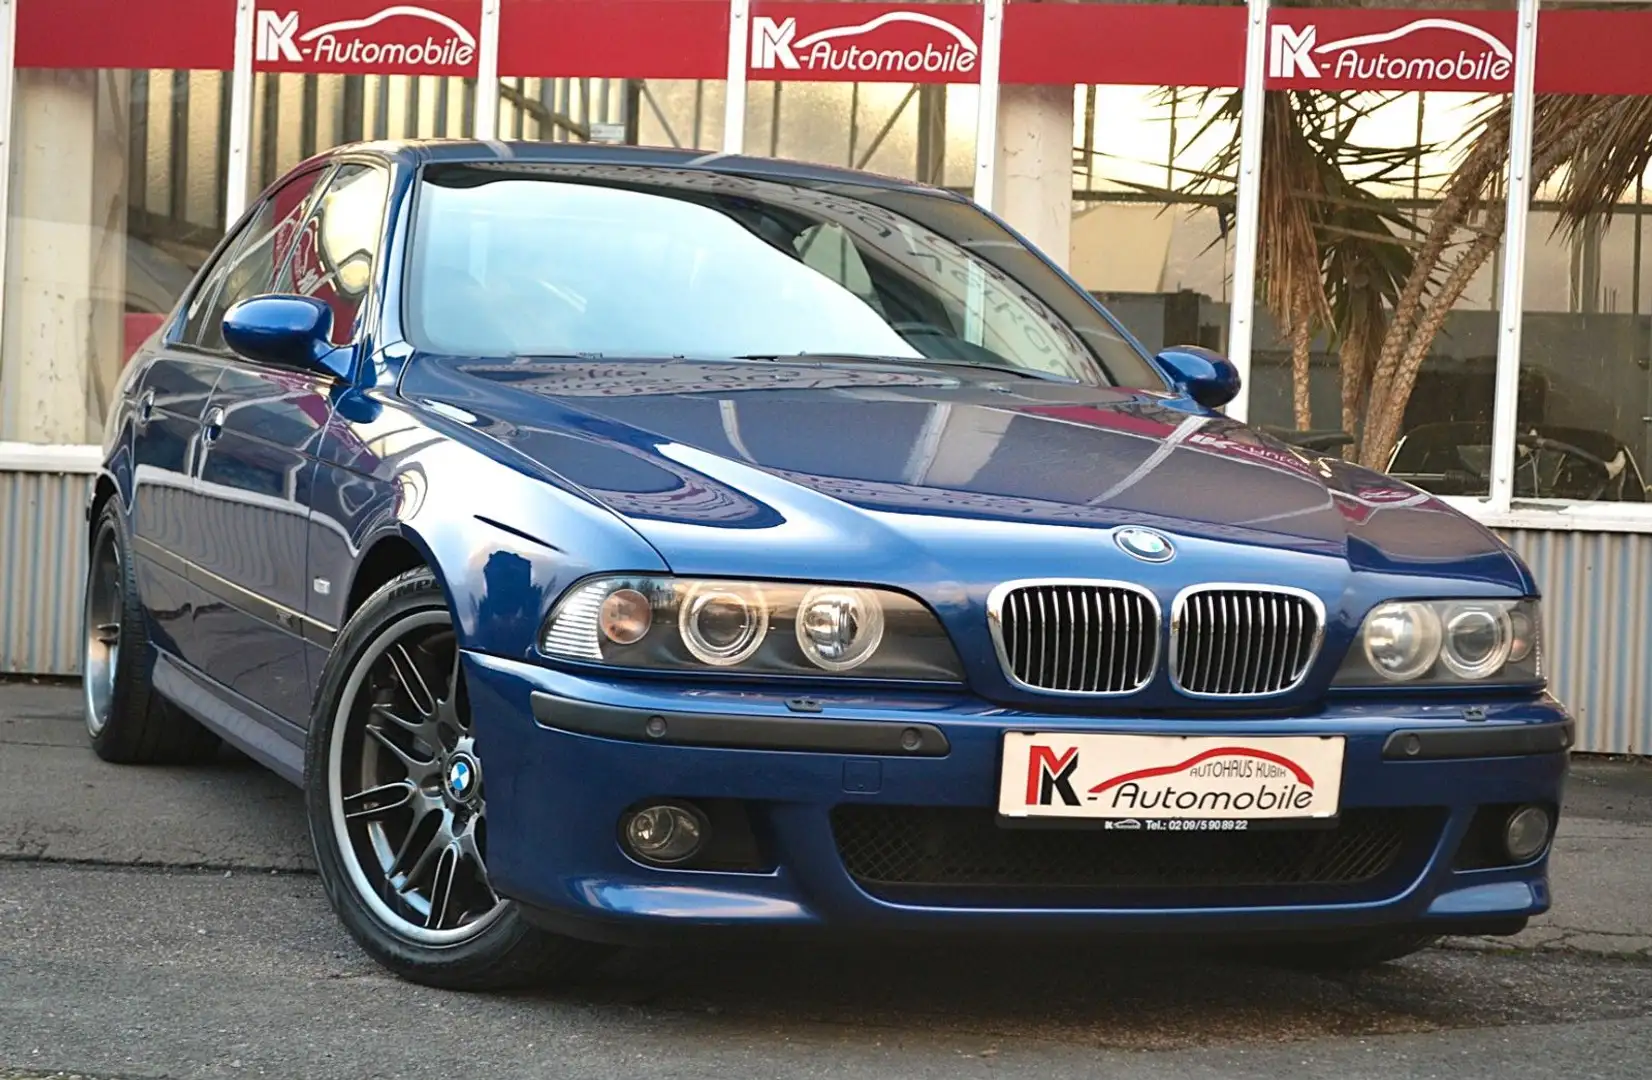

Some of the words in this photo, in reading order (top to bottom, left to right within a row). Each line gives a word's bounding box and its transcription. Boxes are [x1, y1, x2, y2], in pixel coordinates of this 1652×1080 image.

[1189, 759, 1254, 778] AUTOHAUS
[1255, 761, 1287, 778] KUBIK
[1145, 820, 1167, 831] Tel.:
